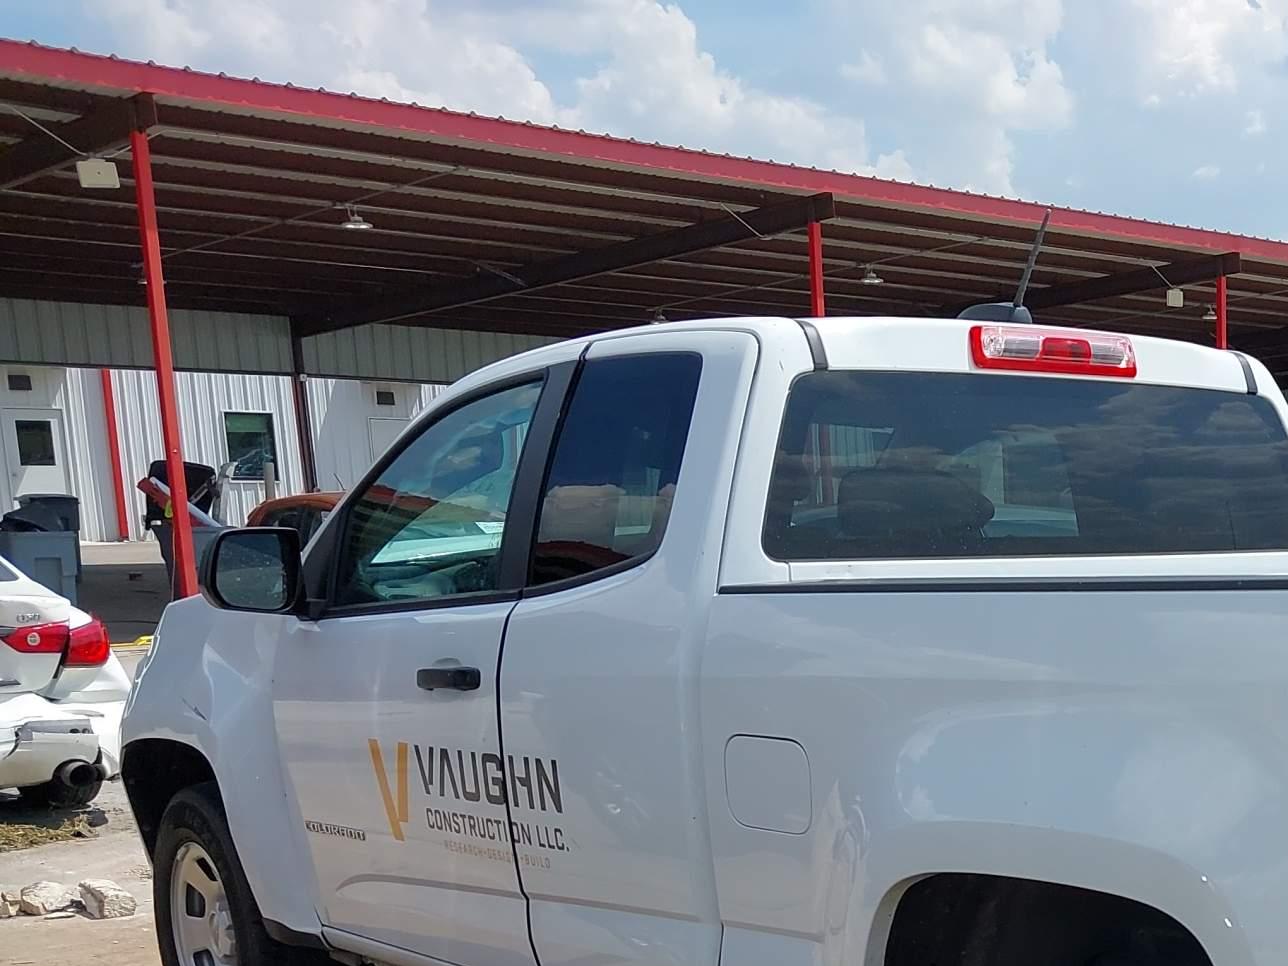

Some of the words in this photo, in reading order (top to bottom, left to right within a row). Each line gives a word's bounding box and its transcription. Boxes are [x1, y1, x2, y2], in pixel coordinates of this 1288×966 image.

[413, 744, 563, 814] VAUGHN
[425, 808, 532, 846] CONSTRUCTION
[535, 824, 570, 852] LLC.
